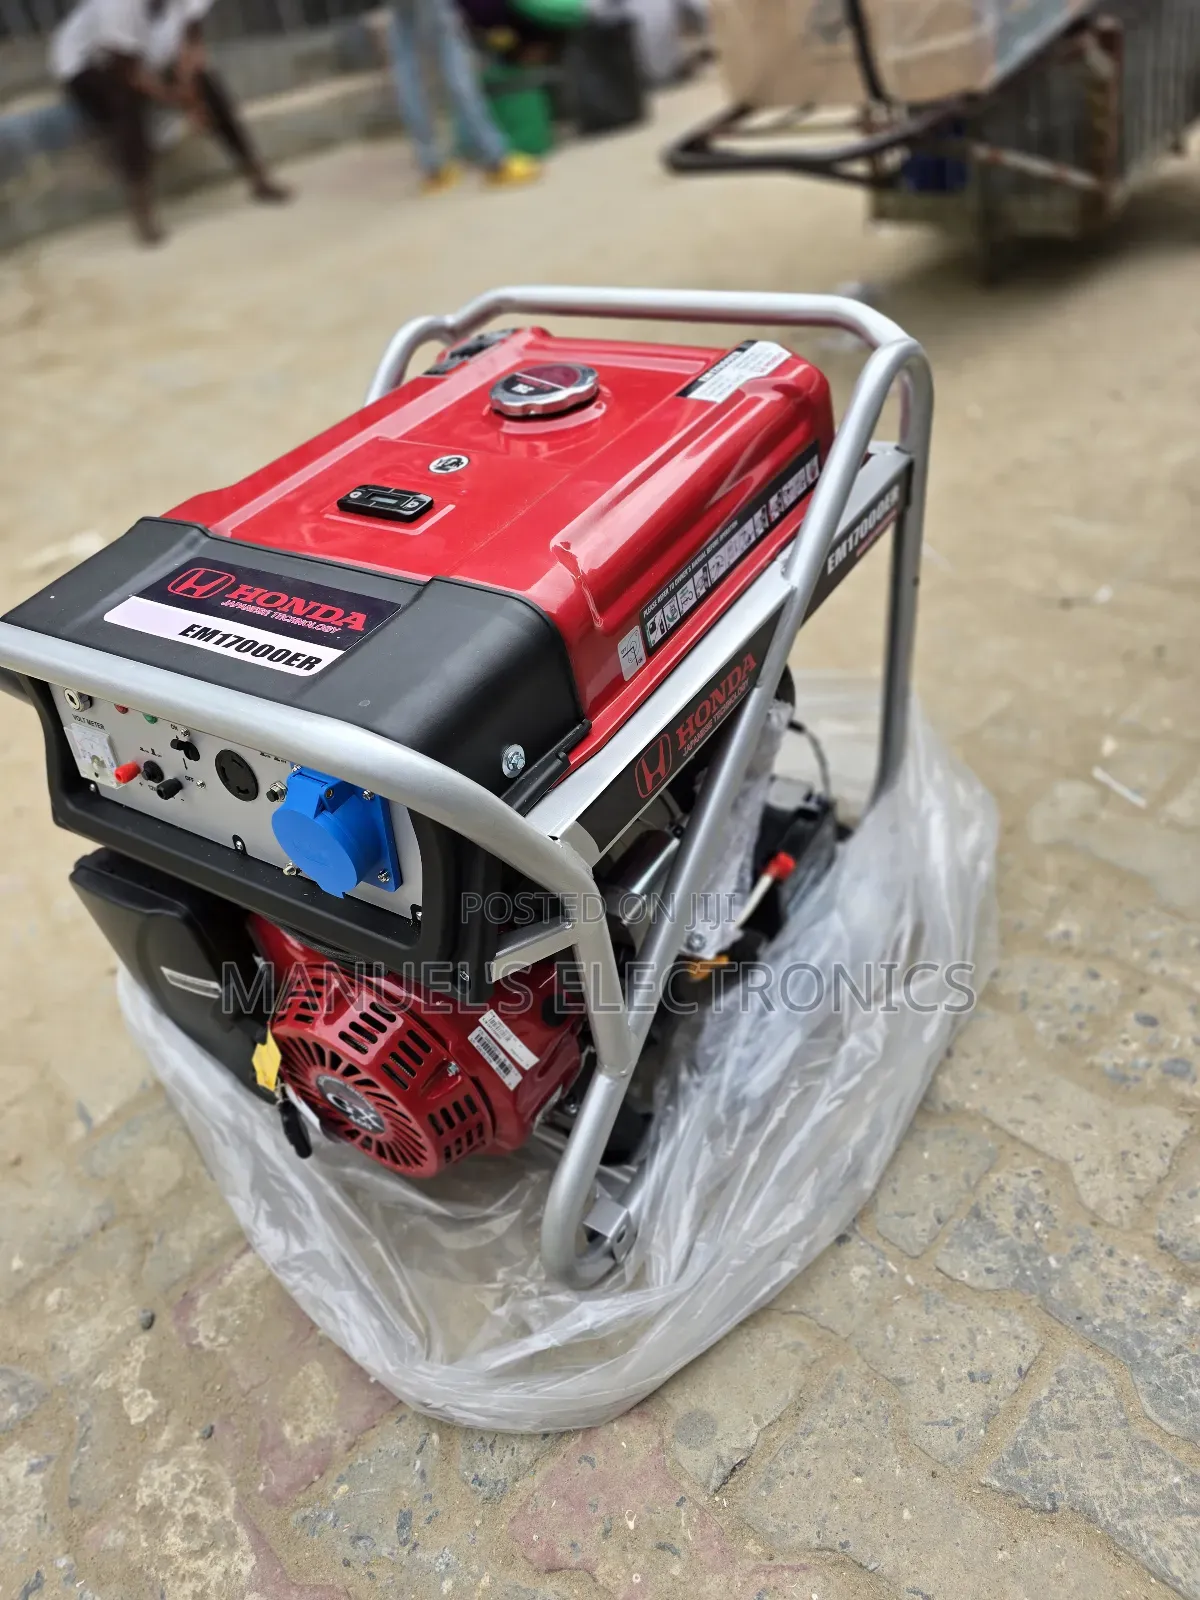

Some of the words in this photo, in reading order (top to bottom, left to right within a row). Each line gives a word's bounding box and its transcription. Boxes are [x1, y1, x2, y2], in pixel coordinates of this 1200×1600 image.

[225, 583, 368, 631] HONDA
[178, 623, 323, 671] EM17000ER
[72, 713, 86, 724] VOLT
[86, 718, 105, 730] METER
[676, 652, 757, 750] HONDA
